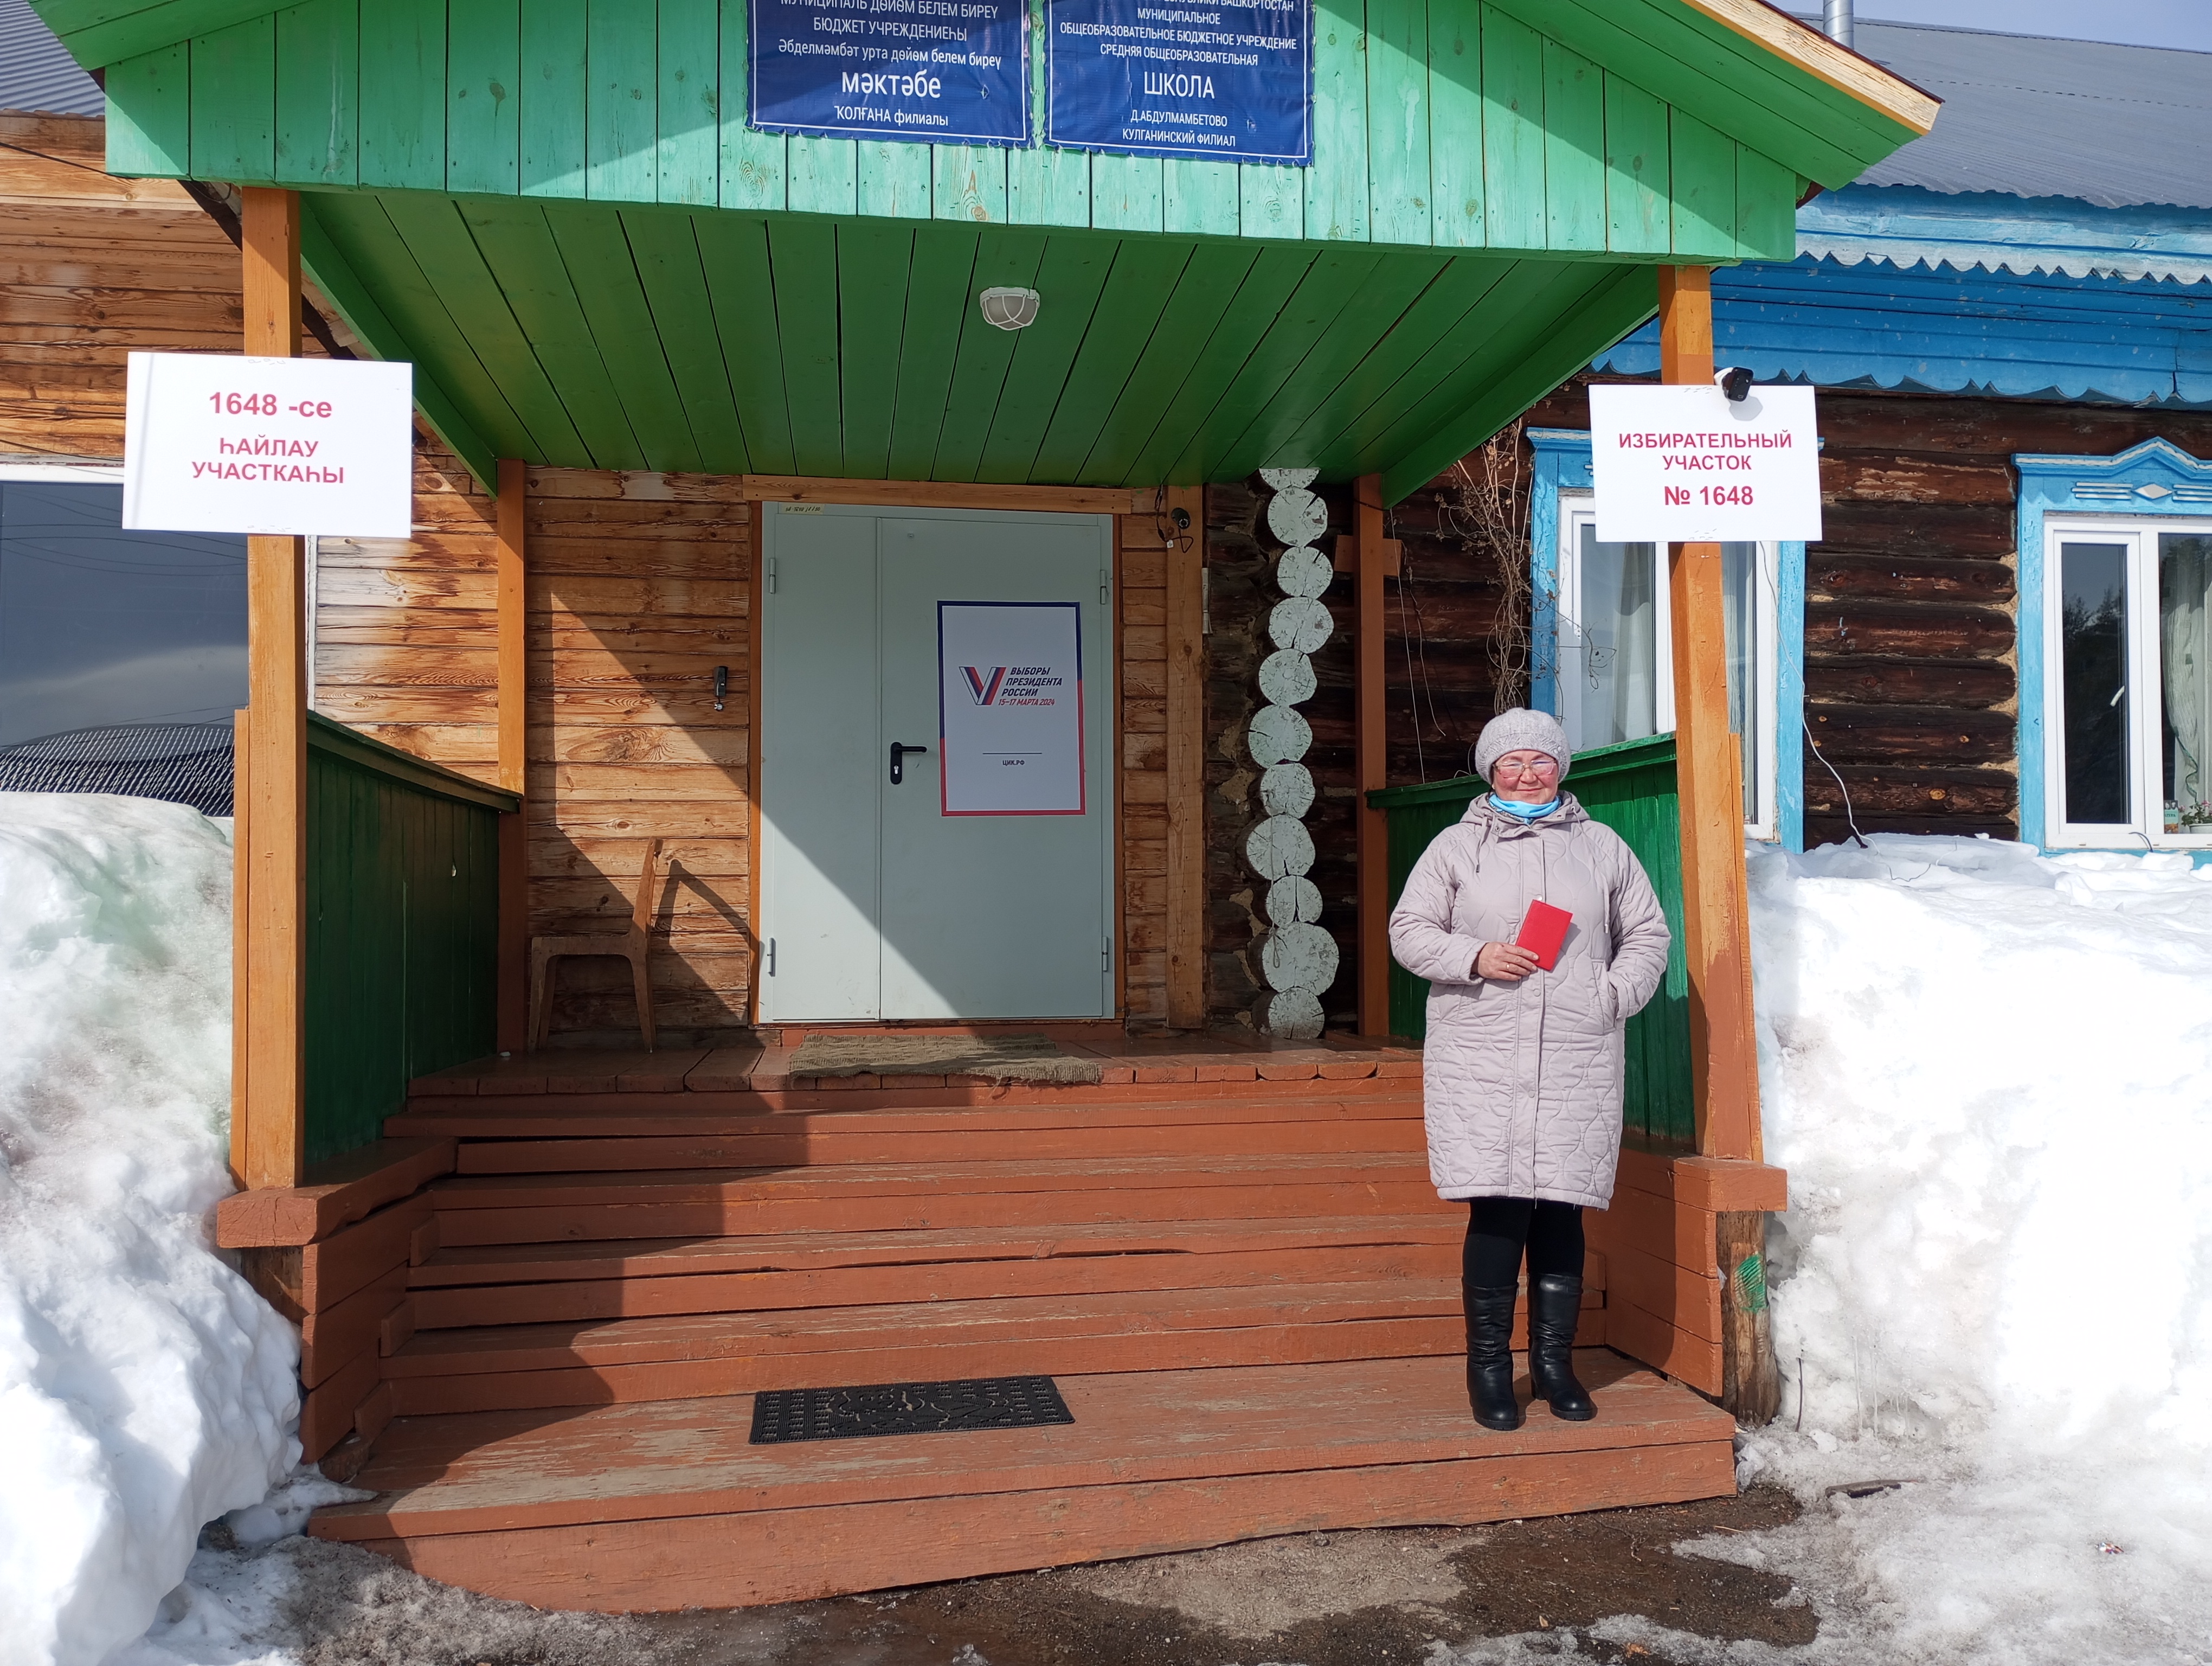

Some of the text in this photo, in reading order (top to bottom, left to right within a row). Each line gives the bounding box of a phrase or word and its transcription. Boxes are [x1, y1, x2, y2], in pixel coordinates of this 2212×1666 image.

[918, 1, 957, 17] БЕЛЕМ
[961, 4, 999, 19] БИРЕҮ
[1137, 7, 1221, 25] МУНИЦИПАЛЬНОЕ
[814, 17, 967, 42] БЮДЖЕТ УЧРЕЖДЕНИЕҺЫ
[1060, 22, 1297, 51] ОБЩЕОБРАЗОВАТЕЛЬНОЕ БЮДЖЕТНОЕ УЧРЕЖДЕНИЕ
[779, 39, 1001, 70] Әбделмәмбәт урта дөйөм белем биреү
[1100, 43, 1258, 66] СРЕДНЯЯ ОБЩЕОБРАЗОВАТЕЛЬНАЯ
[1144, 71, 1215, 99] ШКОЛА
[894, 108, 948, 126] филиалы
[1130, 109, 1227, 127] Д.АБДУЛМАМБЕТОВО
[1122, 128, 1236, 147] КУЛГАНИНСКИЙ ФИЛИАЛ
[209, 392, 278, 416] 1648
[220, 434, 319, 457] ҺАЙЛАУ
[1618, 430, 1792, 448] ИЗБИРАТЕЛЬНЫЙ
[1662, 455, 1752, 470] УЧАСТОК
[192, 461, 344, 484] УЧАСТКАҺЫ
[1664, 485, 1754, 505] № 1648
[1010, 667, 1051, 675] ВЫБОРЫ
[1001, 688, 1039, 696] РОССИИ
[1006, 678, 1063, 687] ПРЕЗИДЕНТА
